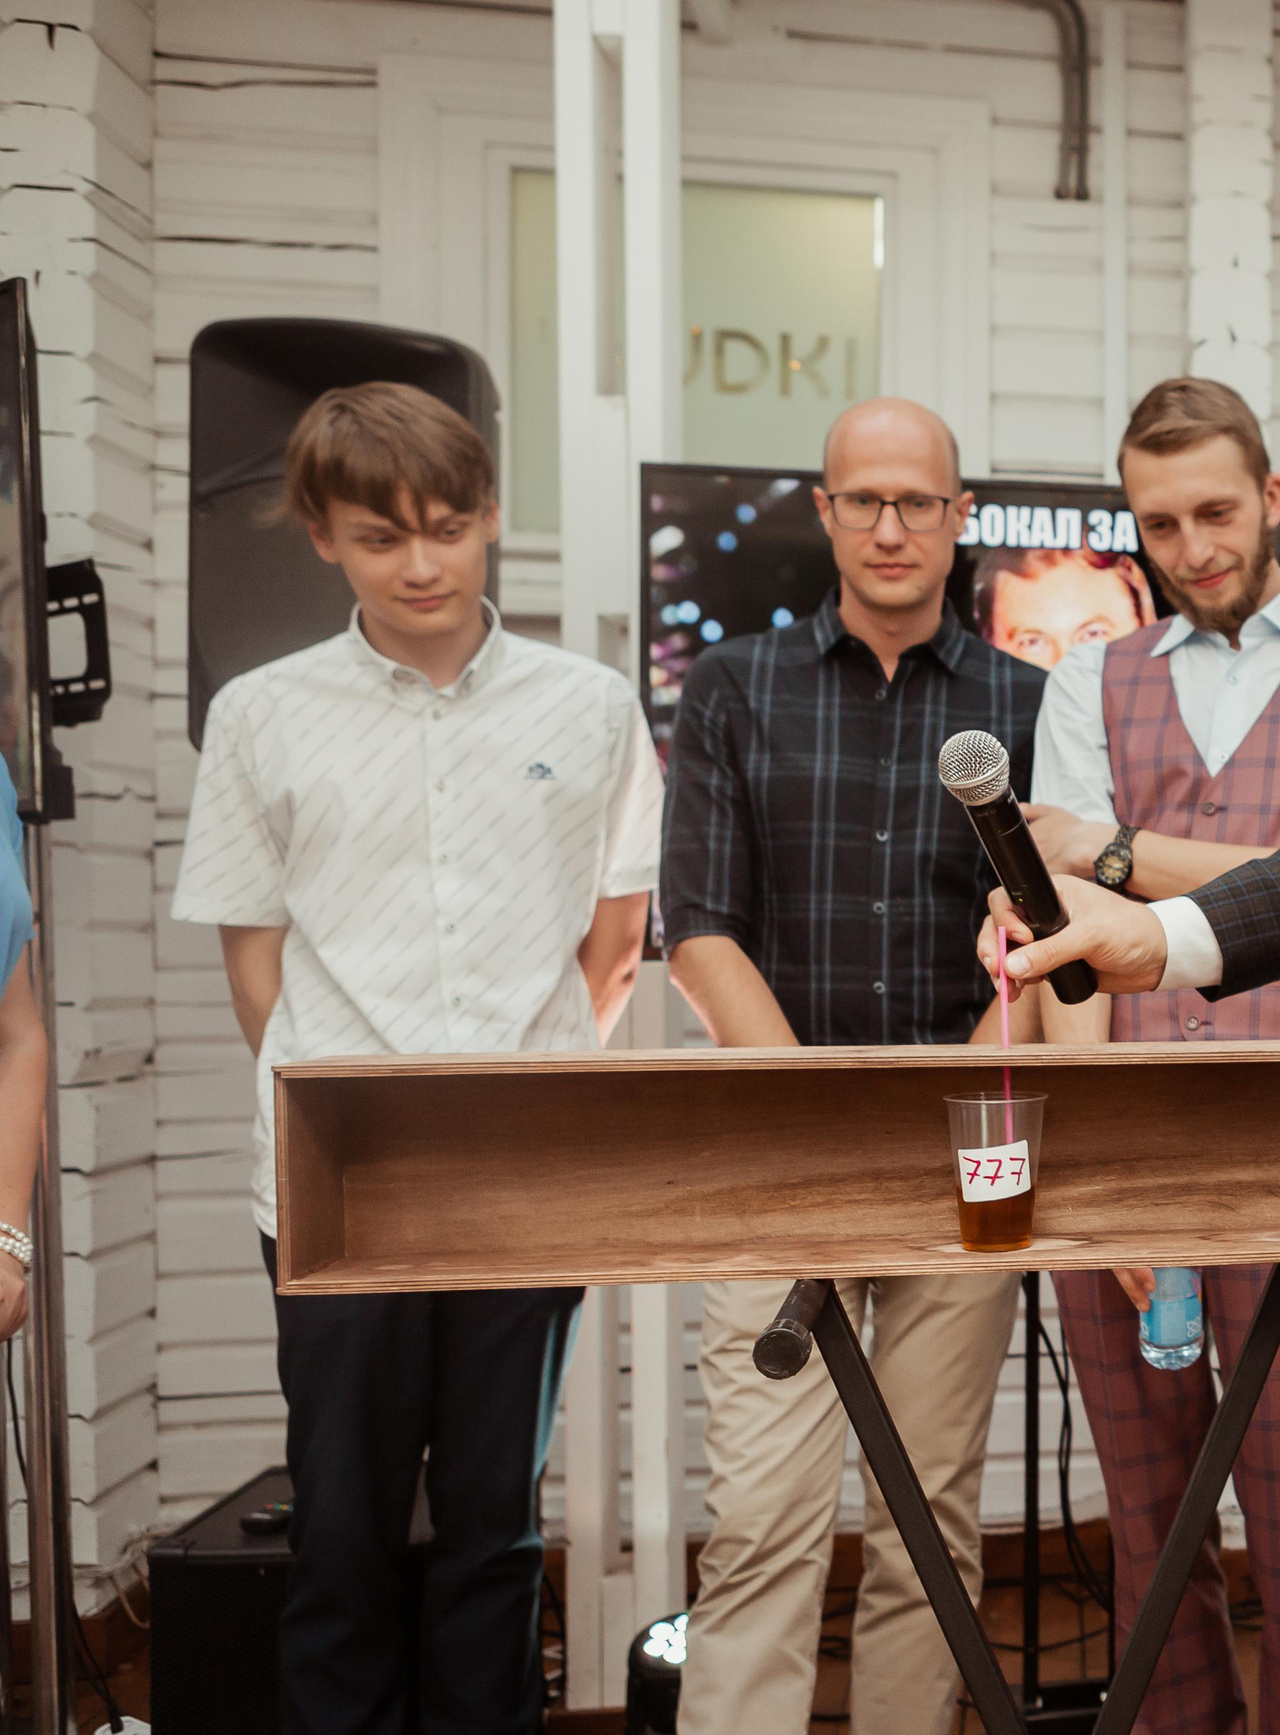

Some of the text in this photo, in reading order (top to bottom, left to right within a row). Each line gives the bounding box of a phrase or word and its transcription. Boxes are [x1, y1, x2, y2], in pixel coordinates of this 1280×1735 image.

[957, 503, 1139, 553] БОКАЛ ЗА
[963, 1156, 1026, 1187] 777
